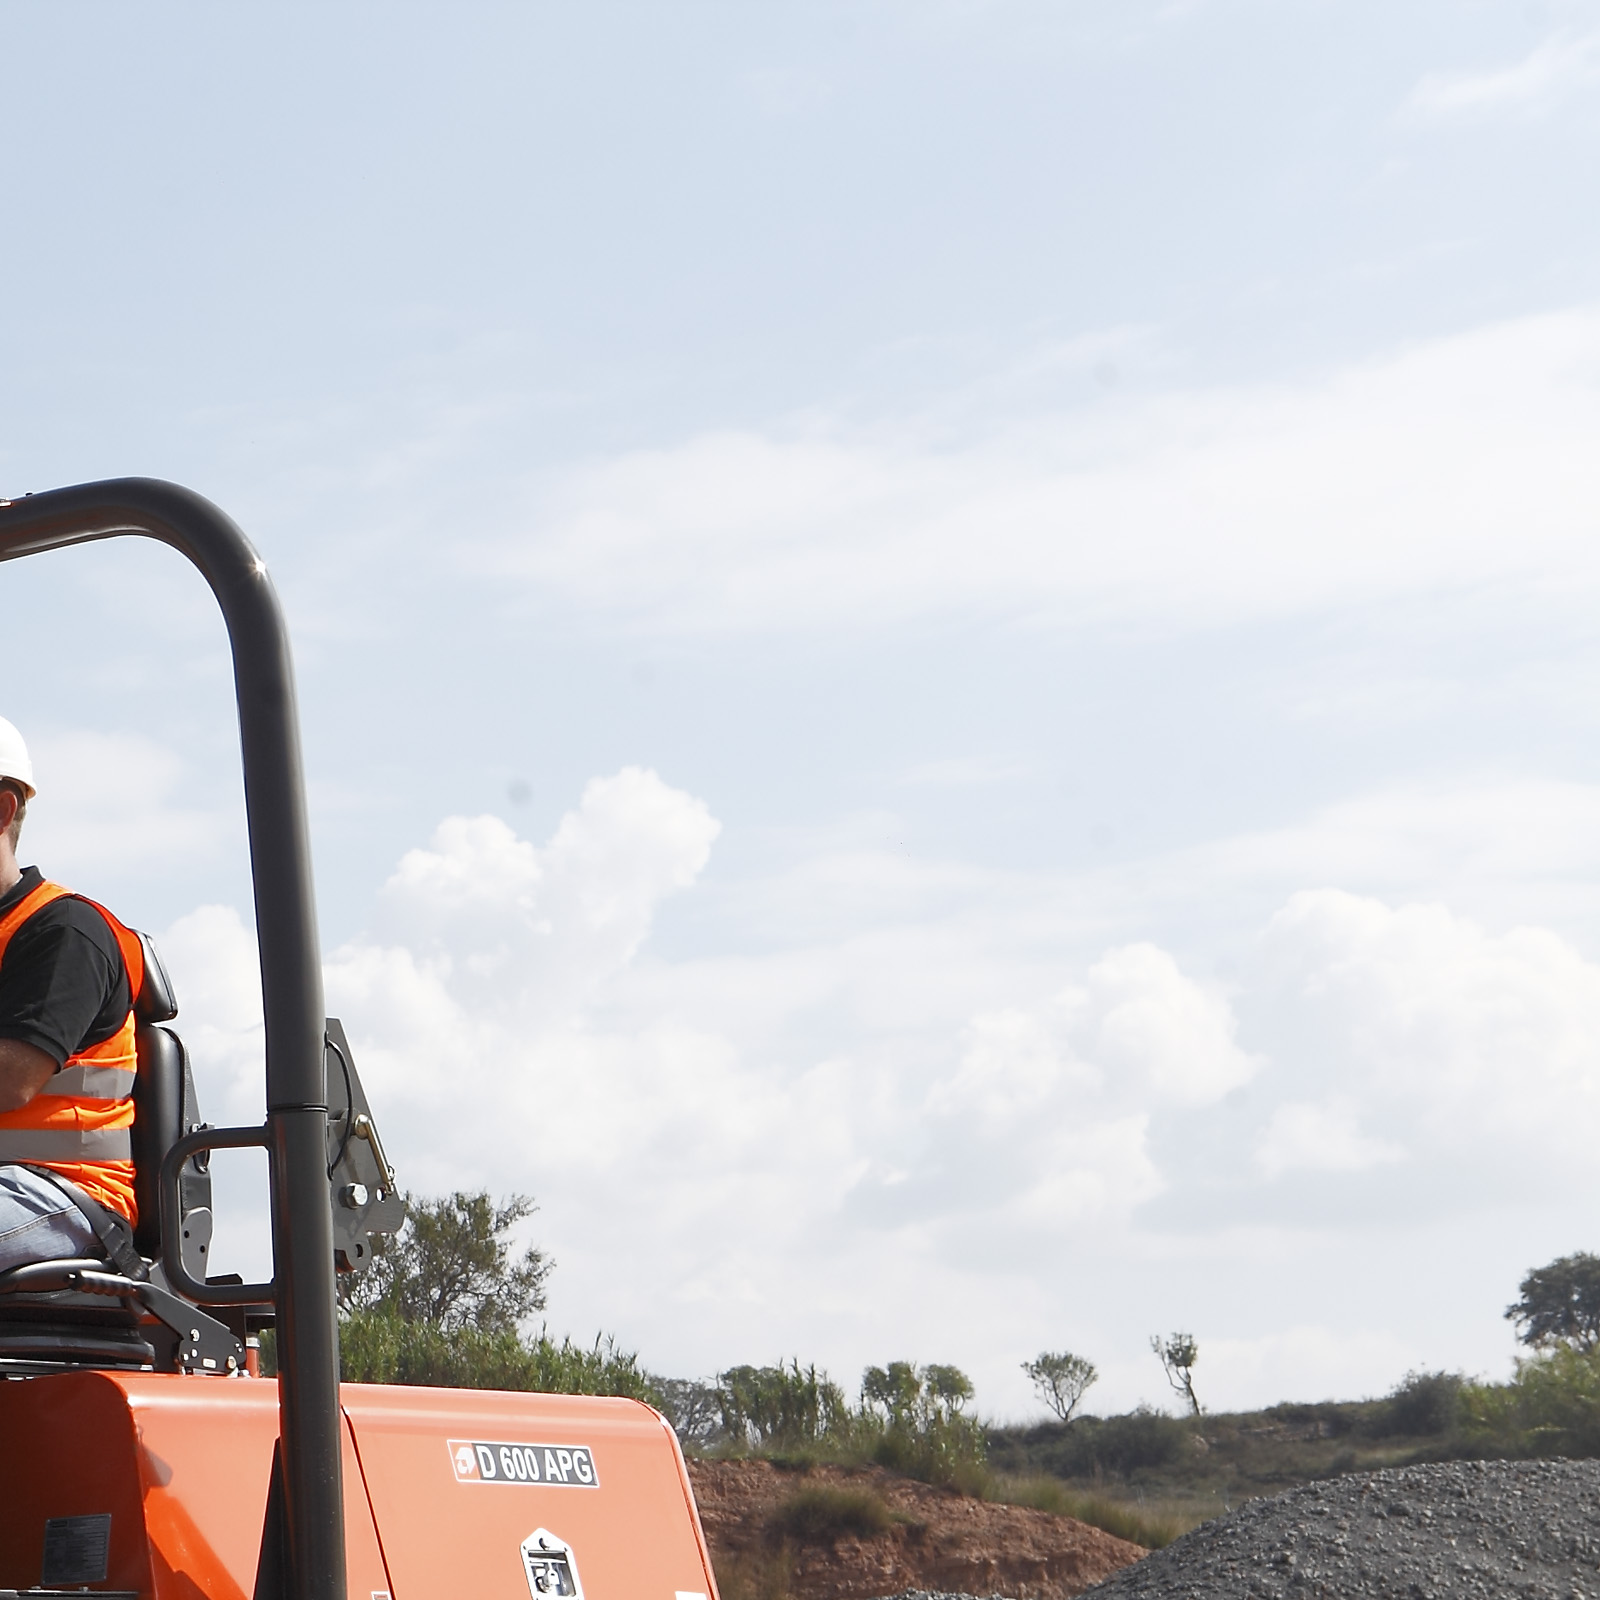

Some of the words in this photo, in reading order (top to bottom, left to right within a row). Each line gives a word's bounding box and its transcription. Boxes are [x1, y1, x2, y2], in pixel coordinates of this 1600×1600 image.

[475, 1445, 497, 1478] D
[499, 1447, 540, 1481] 600
[544, 1449, 593, 1483] APG
